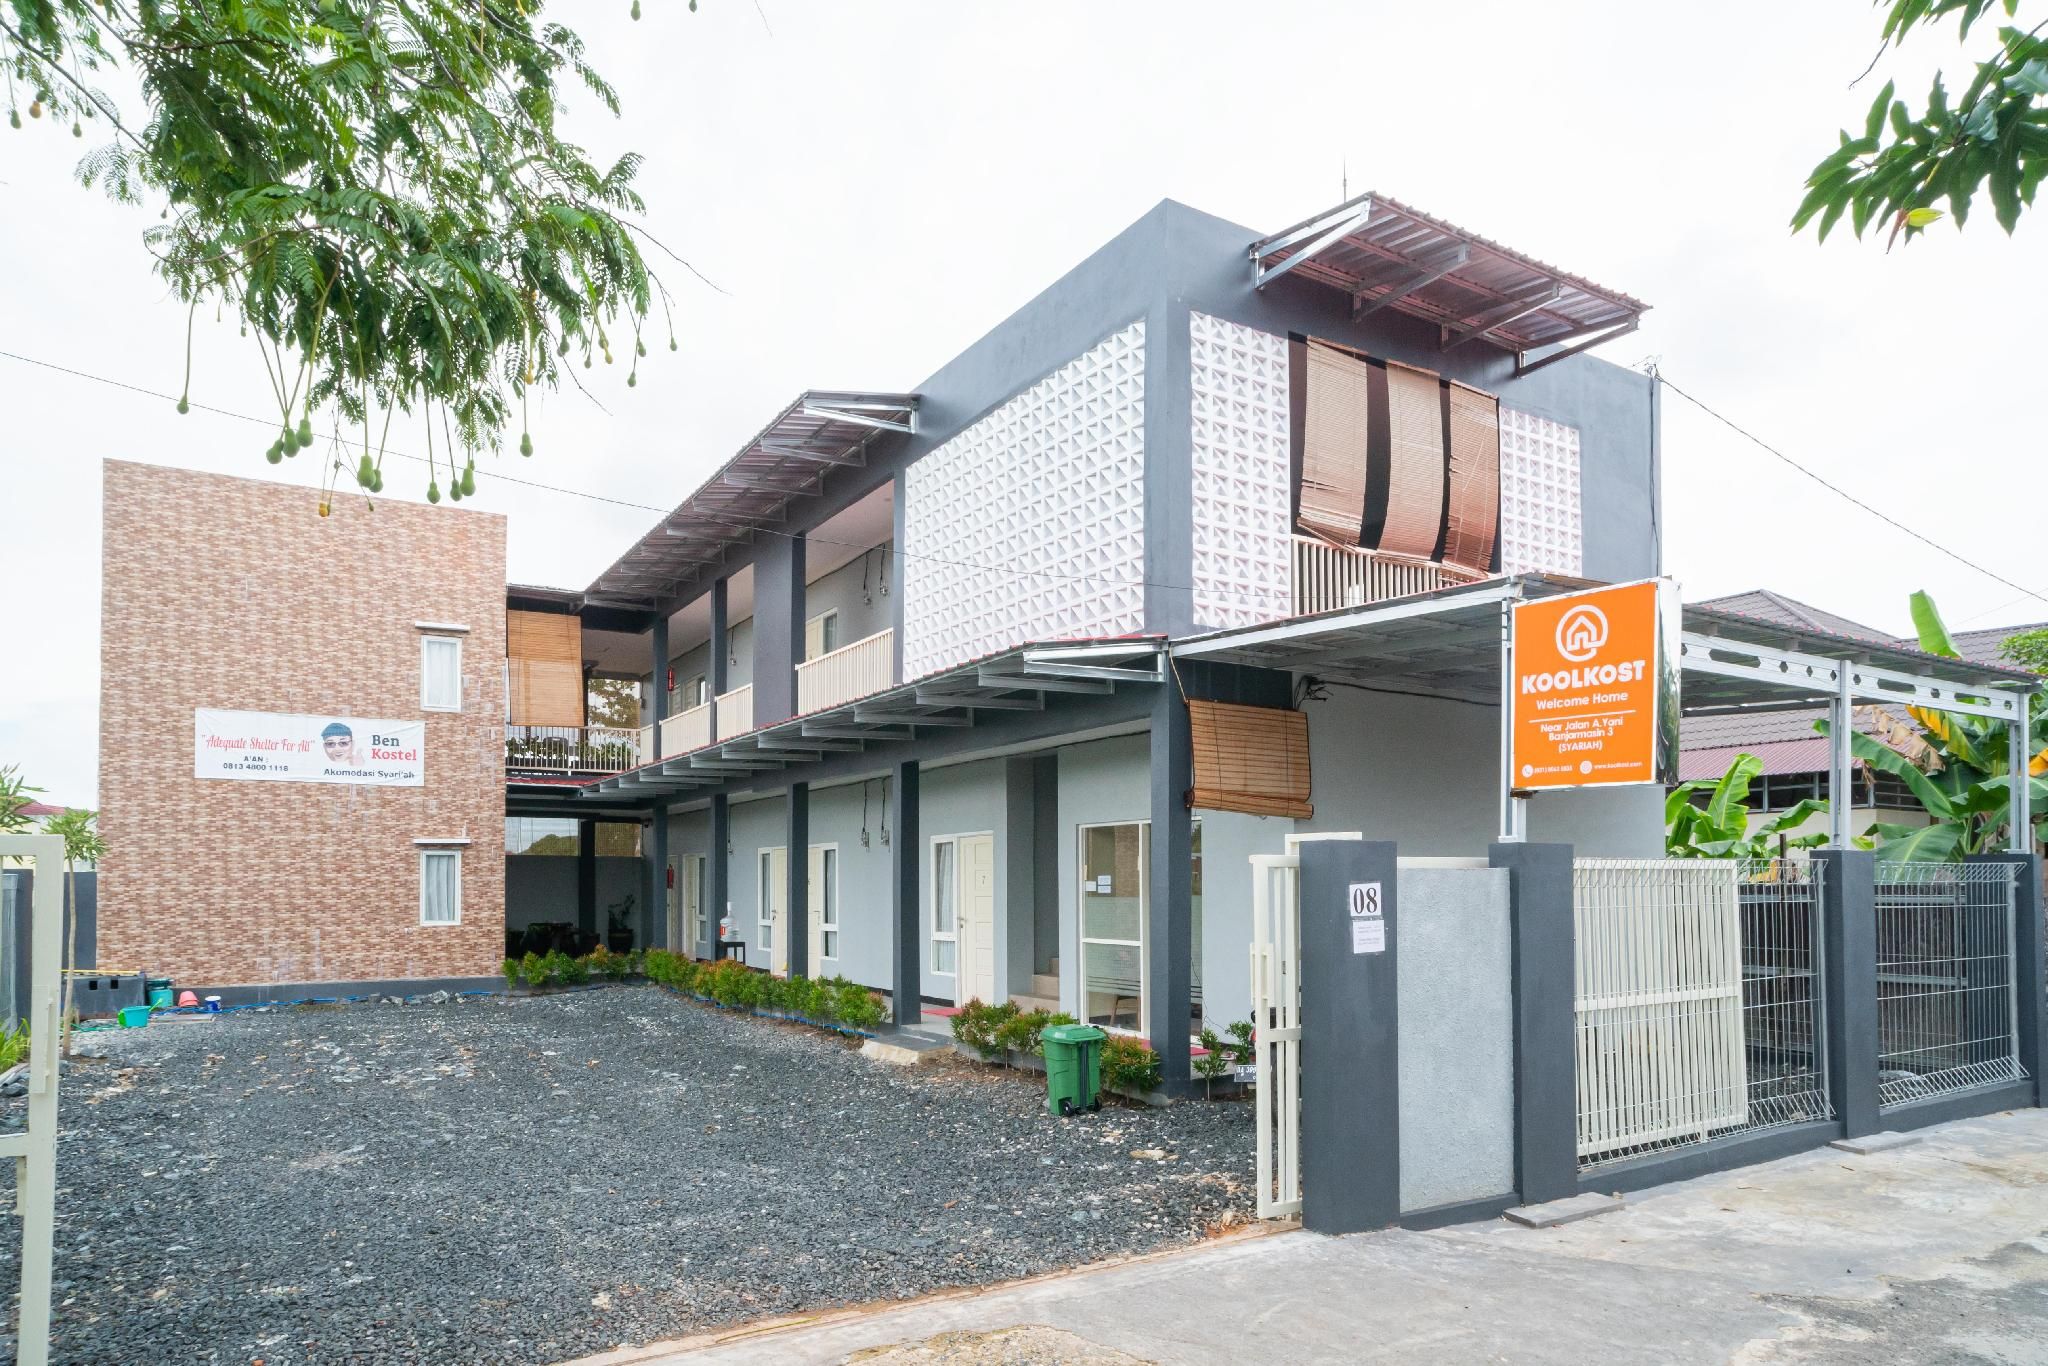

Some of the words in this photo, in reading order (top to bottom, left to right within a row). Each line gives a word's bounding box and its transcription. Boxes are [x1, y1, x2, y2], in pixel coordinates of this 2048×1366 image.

[1522, 659, 1646, 694] KOOLKOST
[1536, 695, 1589, 710] Welcome
[1592, 692, 1629, 704] Home
[1540, 723, 1562, 733] Near
[1565, 719, 1590, 731] Jalan
[372, 734, 400, 746] Ben
[1549, 728, 1605, 741] Banjarmasin
[1607, 727, 1614, 736] 3
[250, 736, 279, 751] Shelter
[281, 739, 296, 752] For
[1558, 740, 1603, 753] (SYARIAH)
[371, 748, 417, 761] Kostel
[223, 762, 244, 770] 0813
[323, 768, 375, 777] Akomodasi
[377, 770, 415, 779] Syari'ah
[1353, 887, 1378, 914] 08
